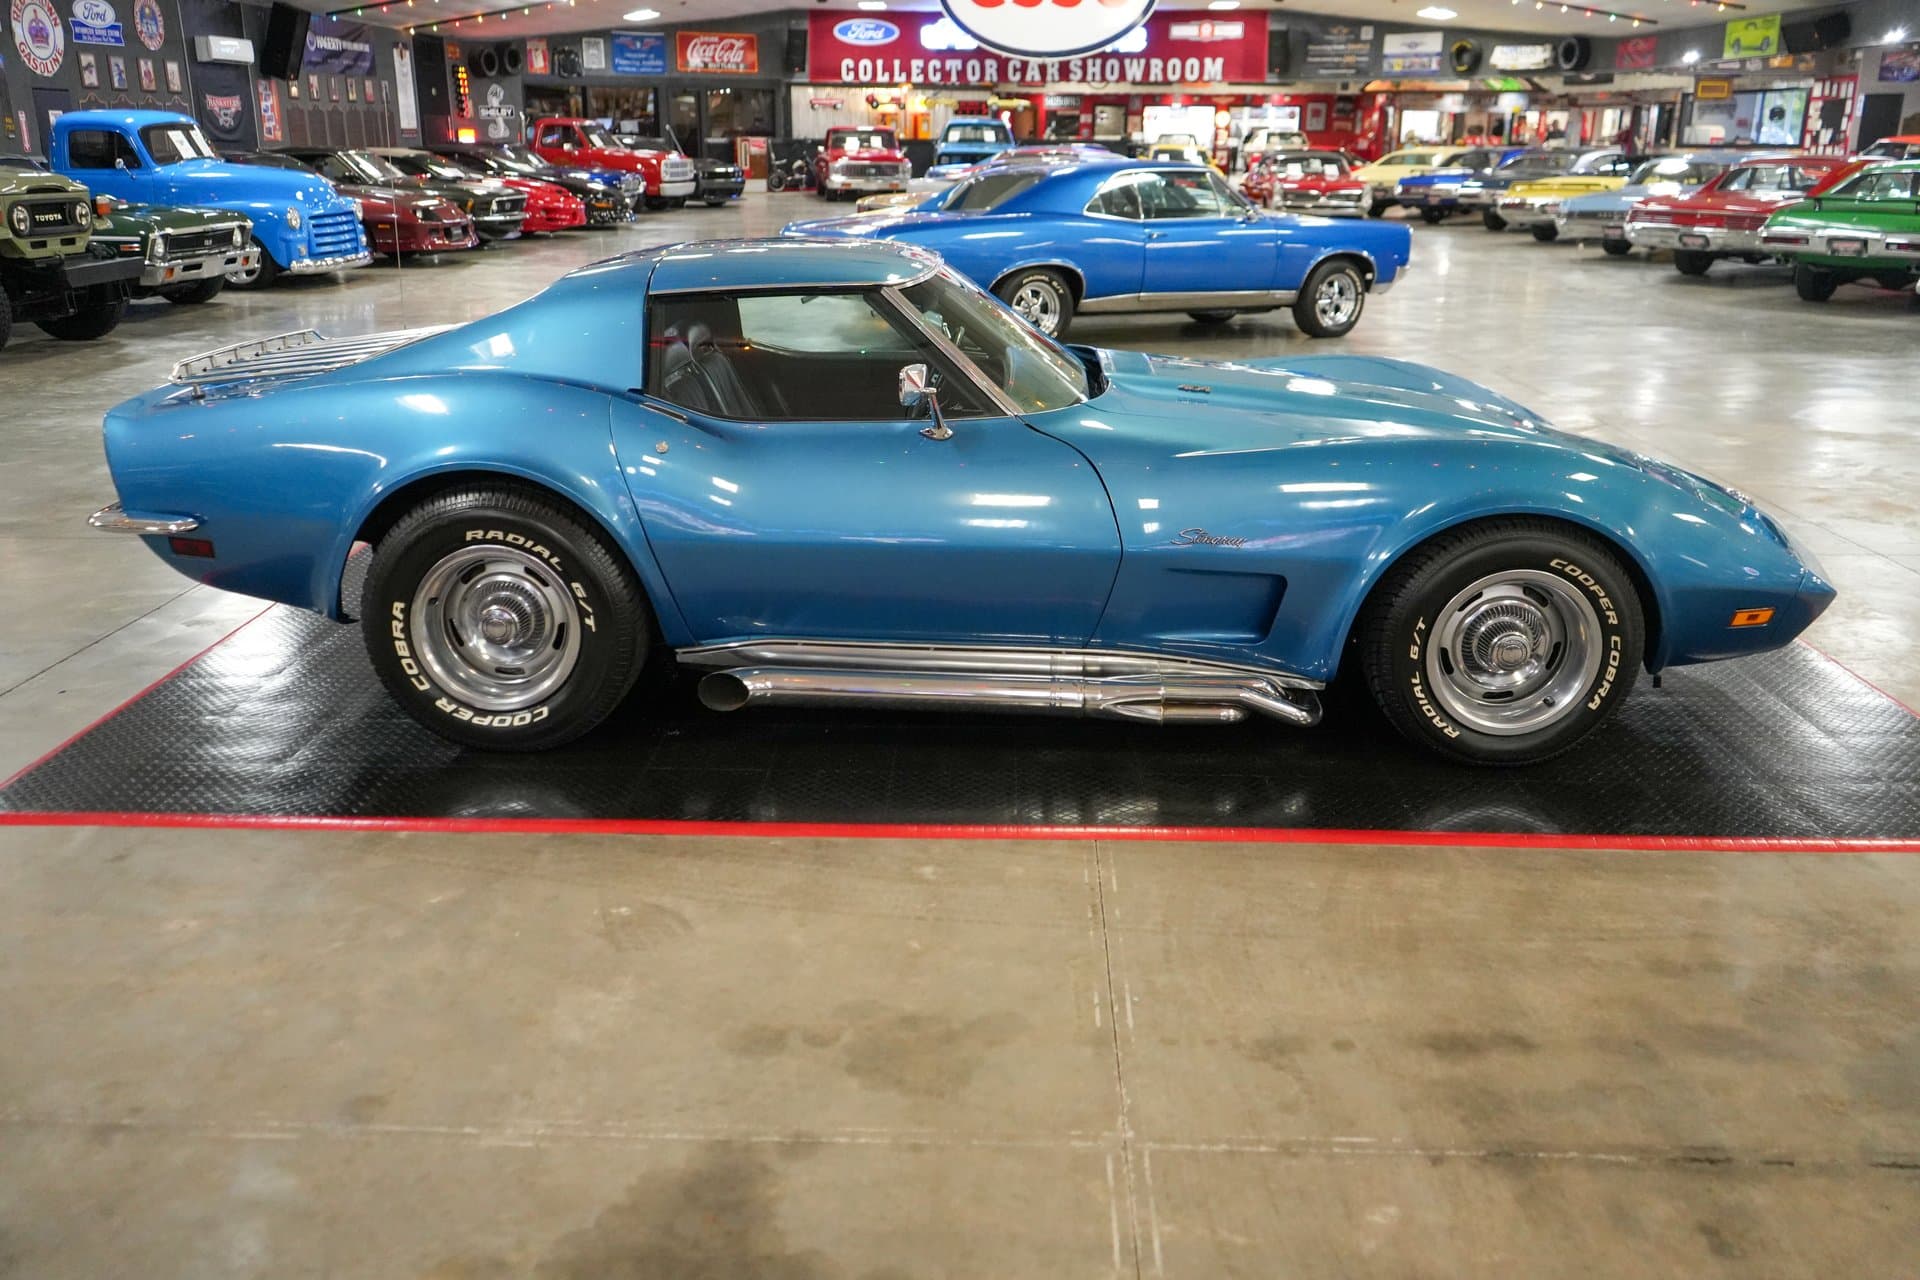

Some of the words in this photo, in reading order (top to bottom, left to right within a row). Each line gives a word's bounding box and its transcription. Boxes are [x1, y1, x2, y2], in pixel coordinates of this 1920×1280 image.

[82, 2, 107, 22] Ford
[847, 23, 886, 40] Ford
[18, 41, 64, 74] GASOLINE
[840, 58, 999, 83] COLLECTOR
[1007, 59, 1060, 83] CAR
[1068, 57, 1225, 82] SHOWROOM
[480, 107, 514, 117] SHELBY
[34, 213, 63, 222] TOYOTA
[1169, 527, 1247, 549] Stingray
[465, 529, 563, 572] RADIAL
[570, 581, 596, 633] G/T
[391, 601, 431, 692] COBRA
[1409, 616, 1427, 661] G/T
[1549, 558, 1619, 626] COOPER
[1586, 635, 1621, 712] COBRA
[434, 696, 552, 728] COOPER
[1410, 671, 1461, 739] RADIAL
